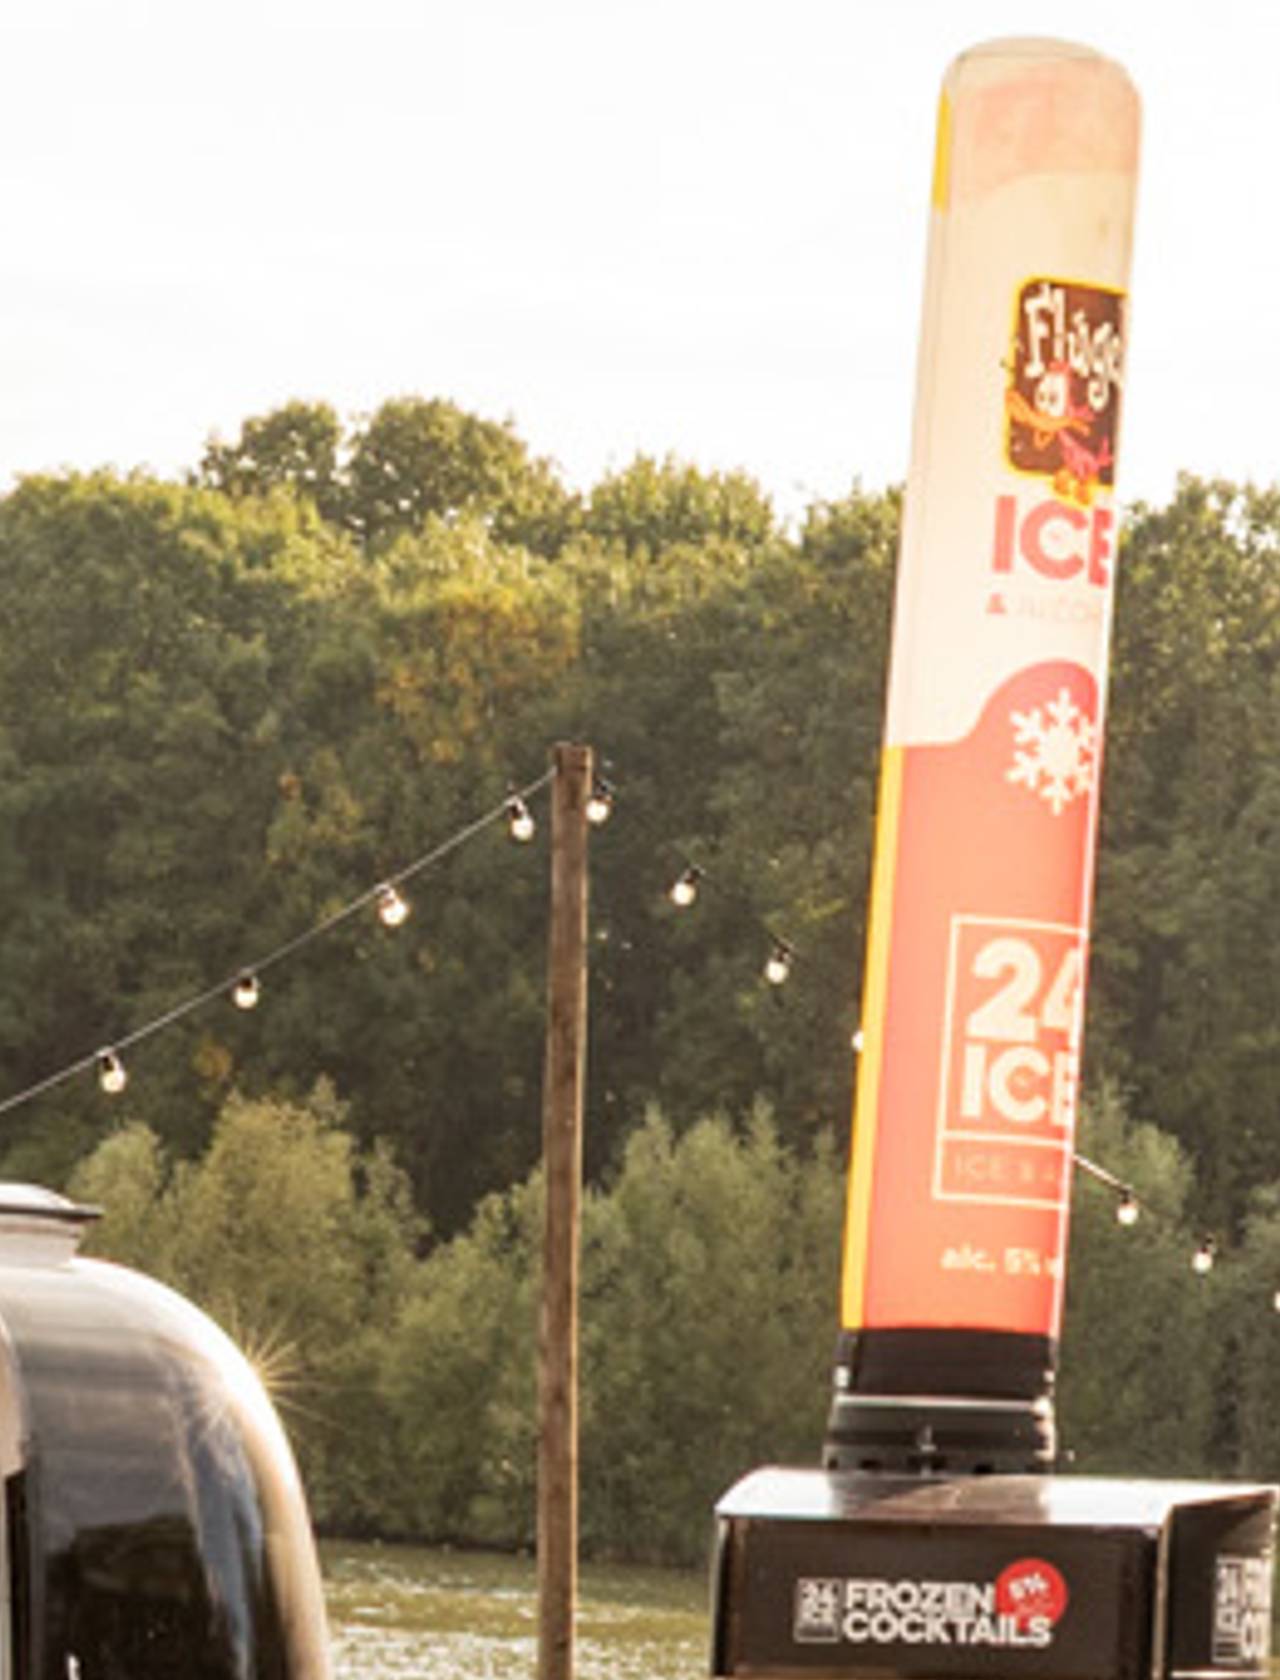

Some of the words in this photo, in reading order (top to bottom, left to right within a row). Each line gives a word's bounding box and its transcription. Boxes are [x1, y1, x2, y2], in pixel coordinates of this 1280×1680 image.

[992, 495, 1113, 587] ICE
[845, 1580, 996, 1614] FROZEN
[842, 1611, 1053, 1648] COCKTAILS
